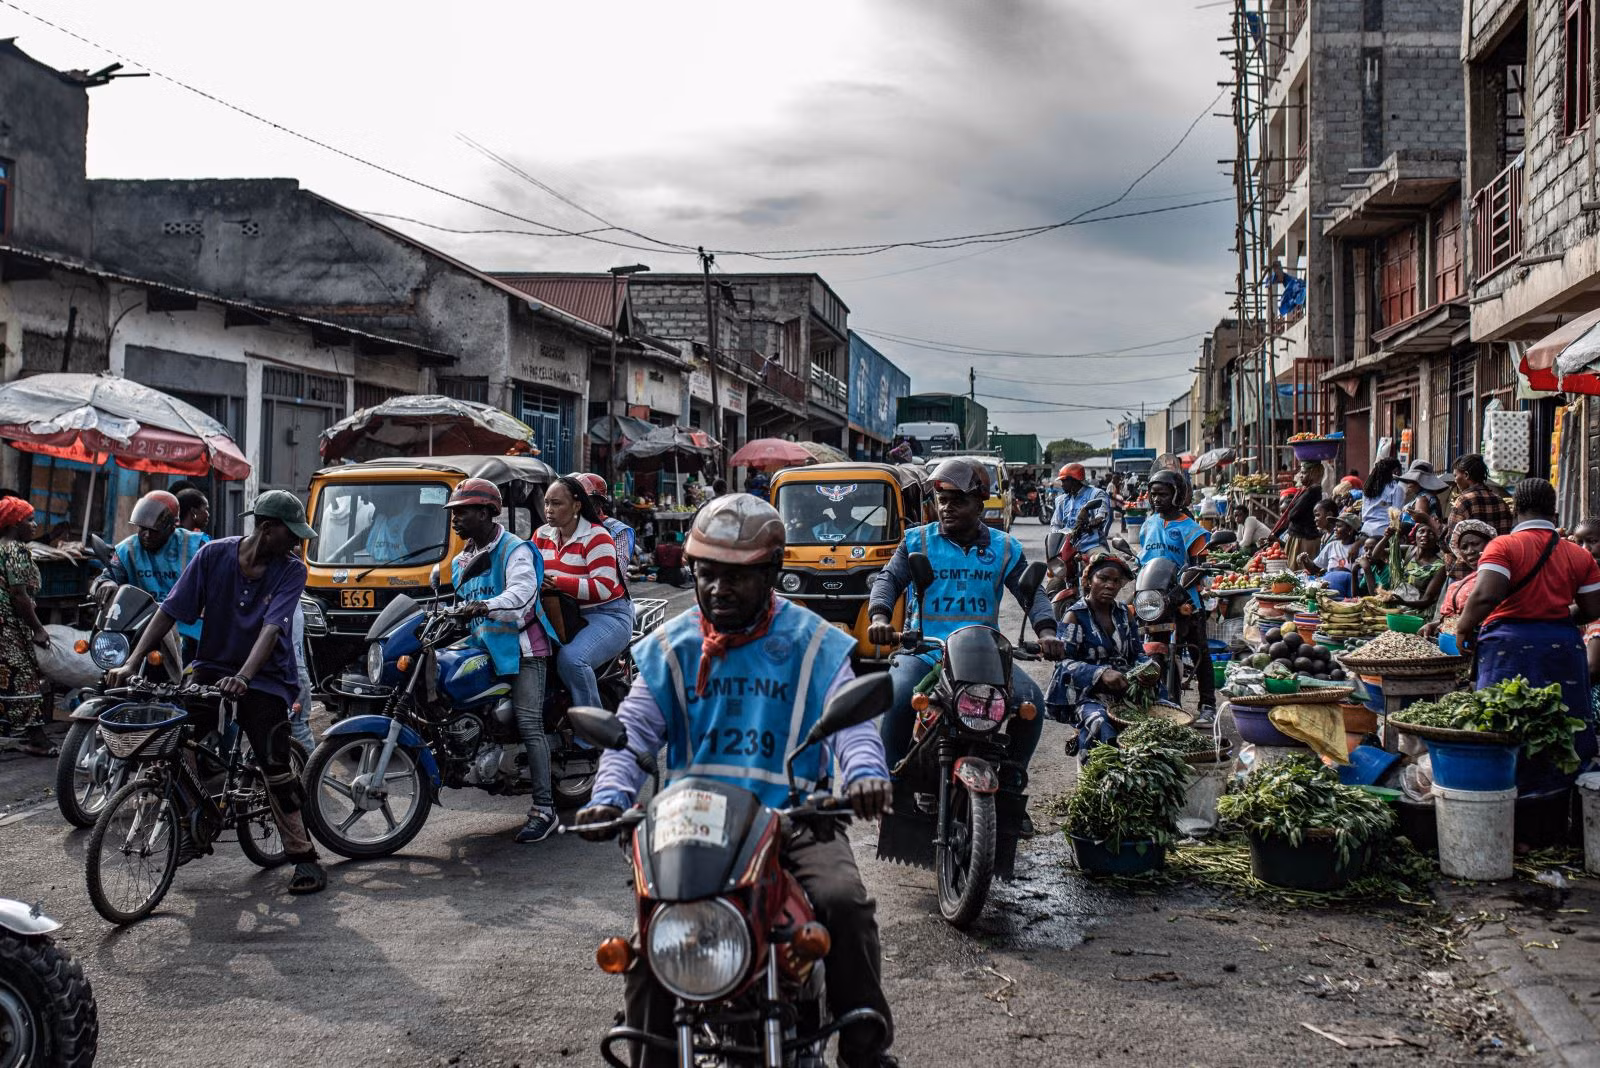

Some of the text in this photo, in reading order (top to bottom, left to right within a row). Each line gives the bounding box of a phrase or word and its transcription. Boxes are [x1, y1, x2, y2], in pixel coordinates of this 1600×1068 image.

[933, 568, 992, 581] CCMT-NK
[931, 596, 987, 613] 17119
[701, 728, 776, 758] 1239
